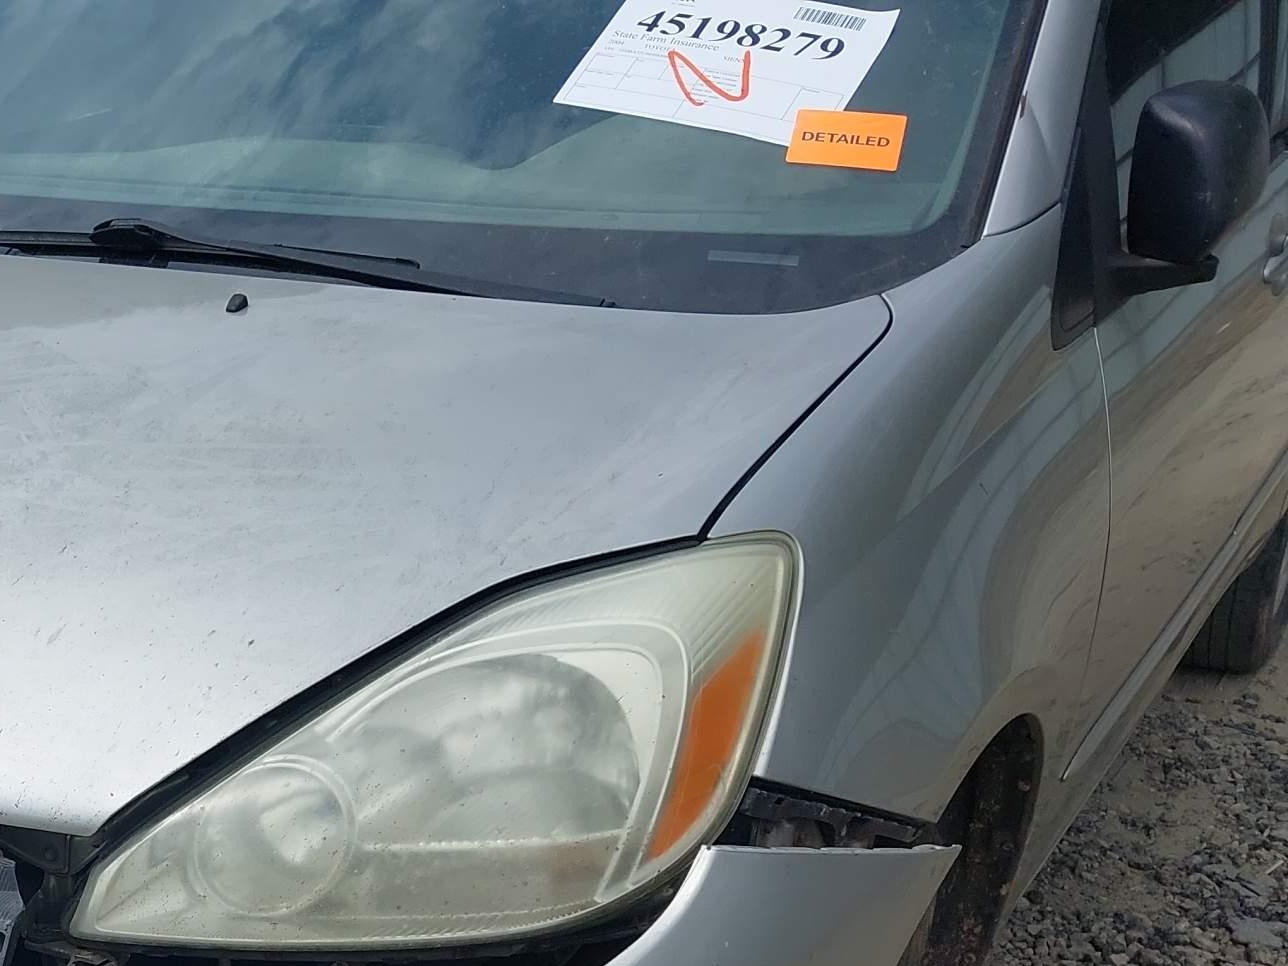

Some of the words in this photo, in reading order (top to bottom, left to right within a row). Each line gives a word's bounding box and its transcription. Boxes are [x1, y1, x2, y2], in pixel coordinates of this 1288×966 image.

[612, 30, 639, 40] State
[640, 34, 668, 45] Farm
[669, 37, 721, 52] Insurance
[636, 10, 846, 60] 45198279
[801, 130, 891, 149] DETAILED
